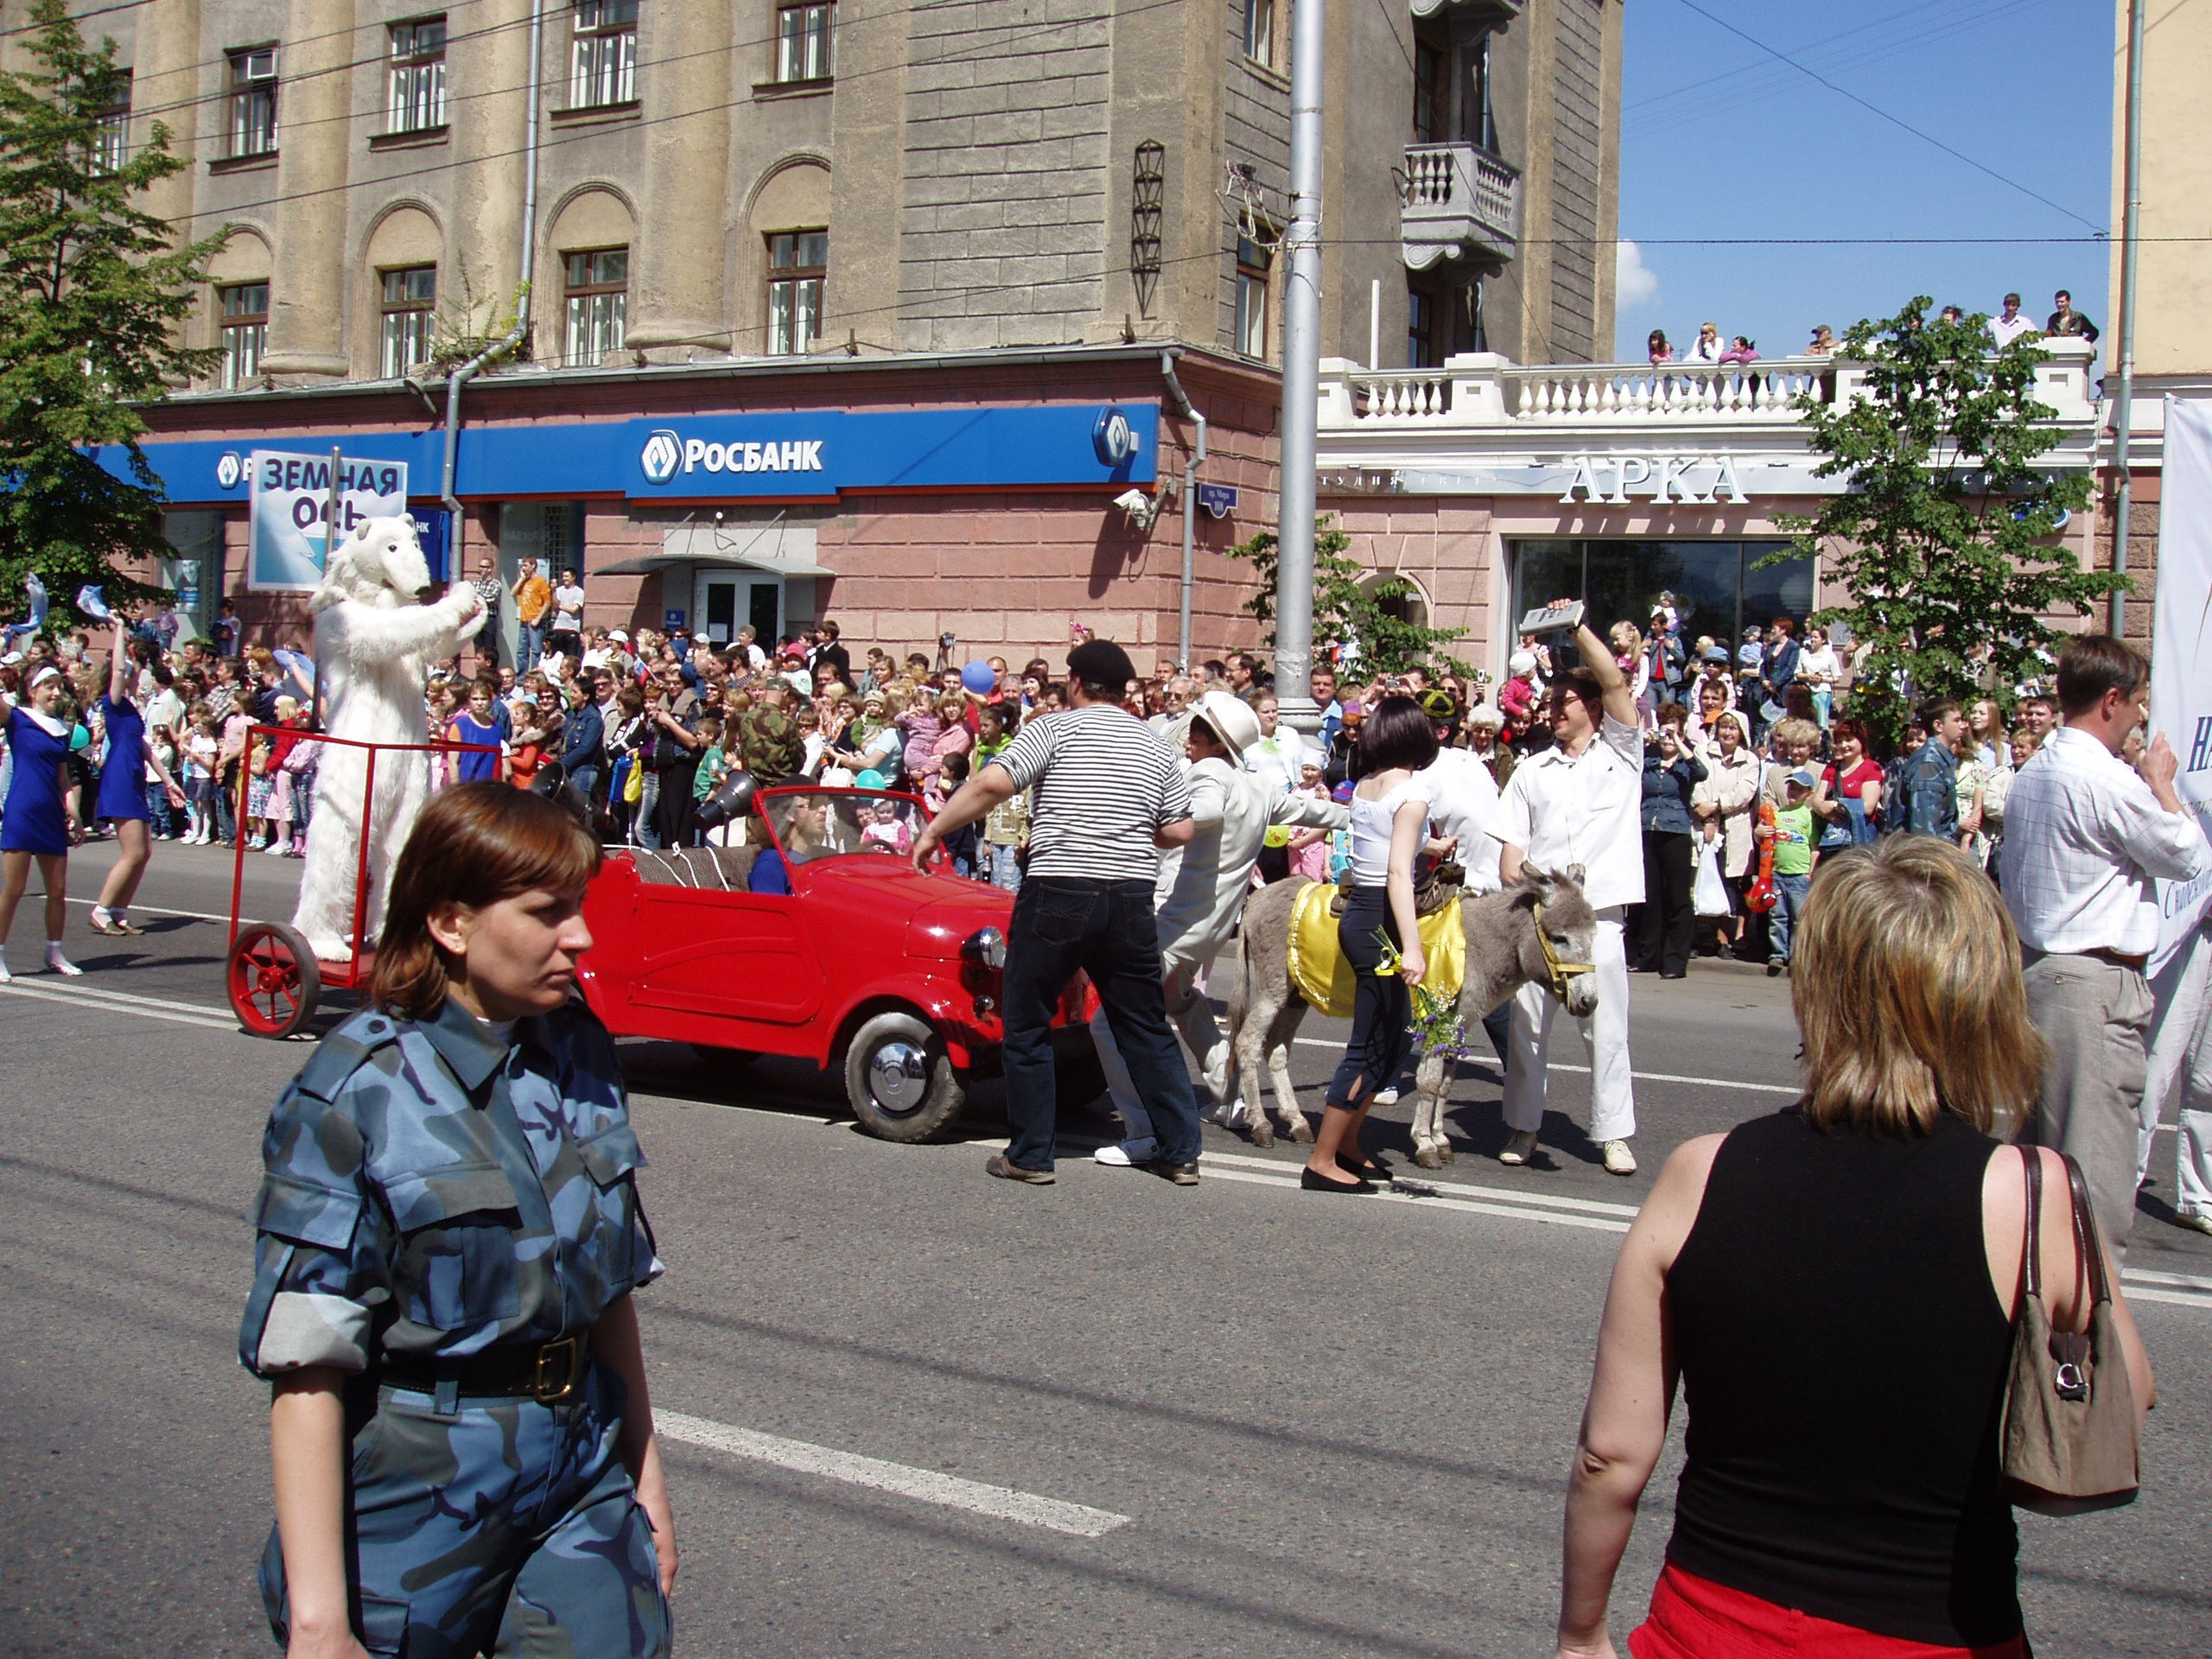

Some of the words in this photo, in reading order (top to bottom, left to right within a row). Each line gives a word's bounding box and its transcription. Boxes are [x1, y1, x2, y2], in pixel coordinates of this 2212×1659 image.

[684, 439, 823, 474] РОСБАНК
[264, 458, 398, 497] ЗЕМНАЯ
[1320, 475, 1398, 486] ТУДИЯ
[1559, 456, 1751, 504] АРКА
[292, 496, 368, 531] ОСЬ
